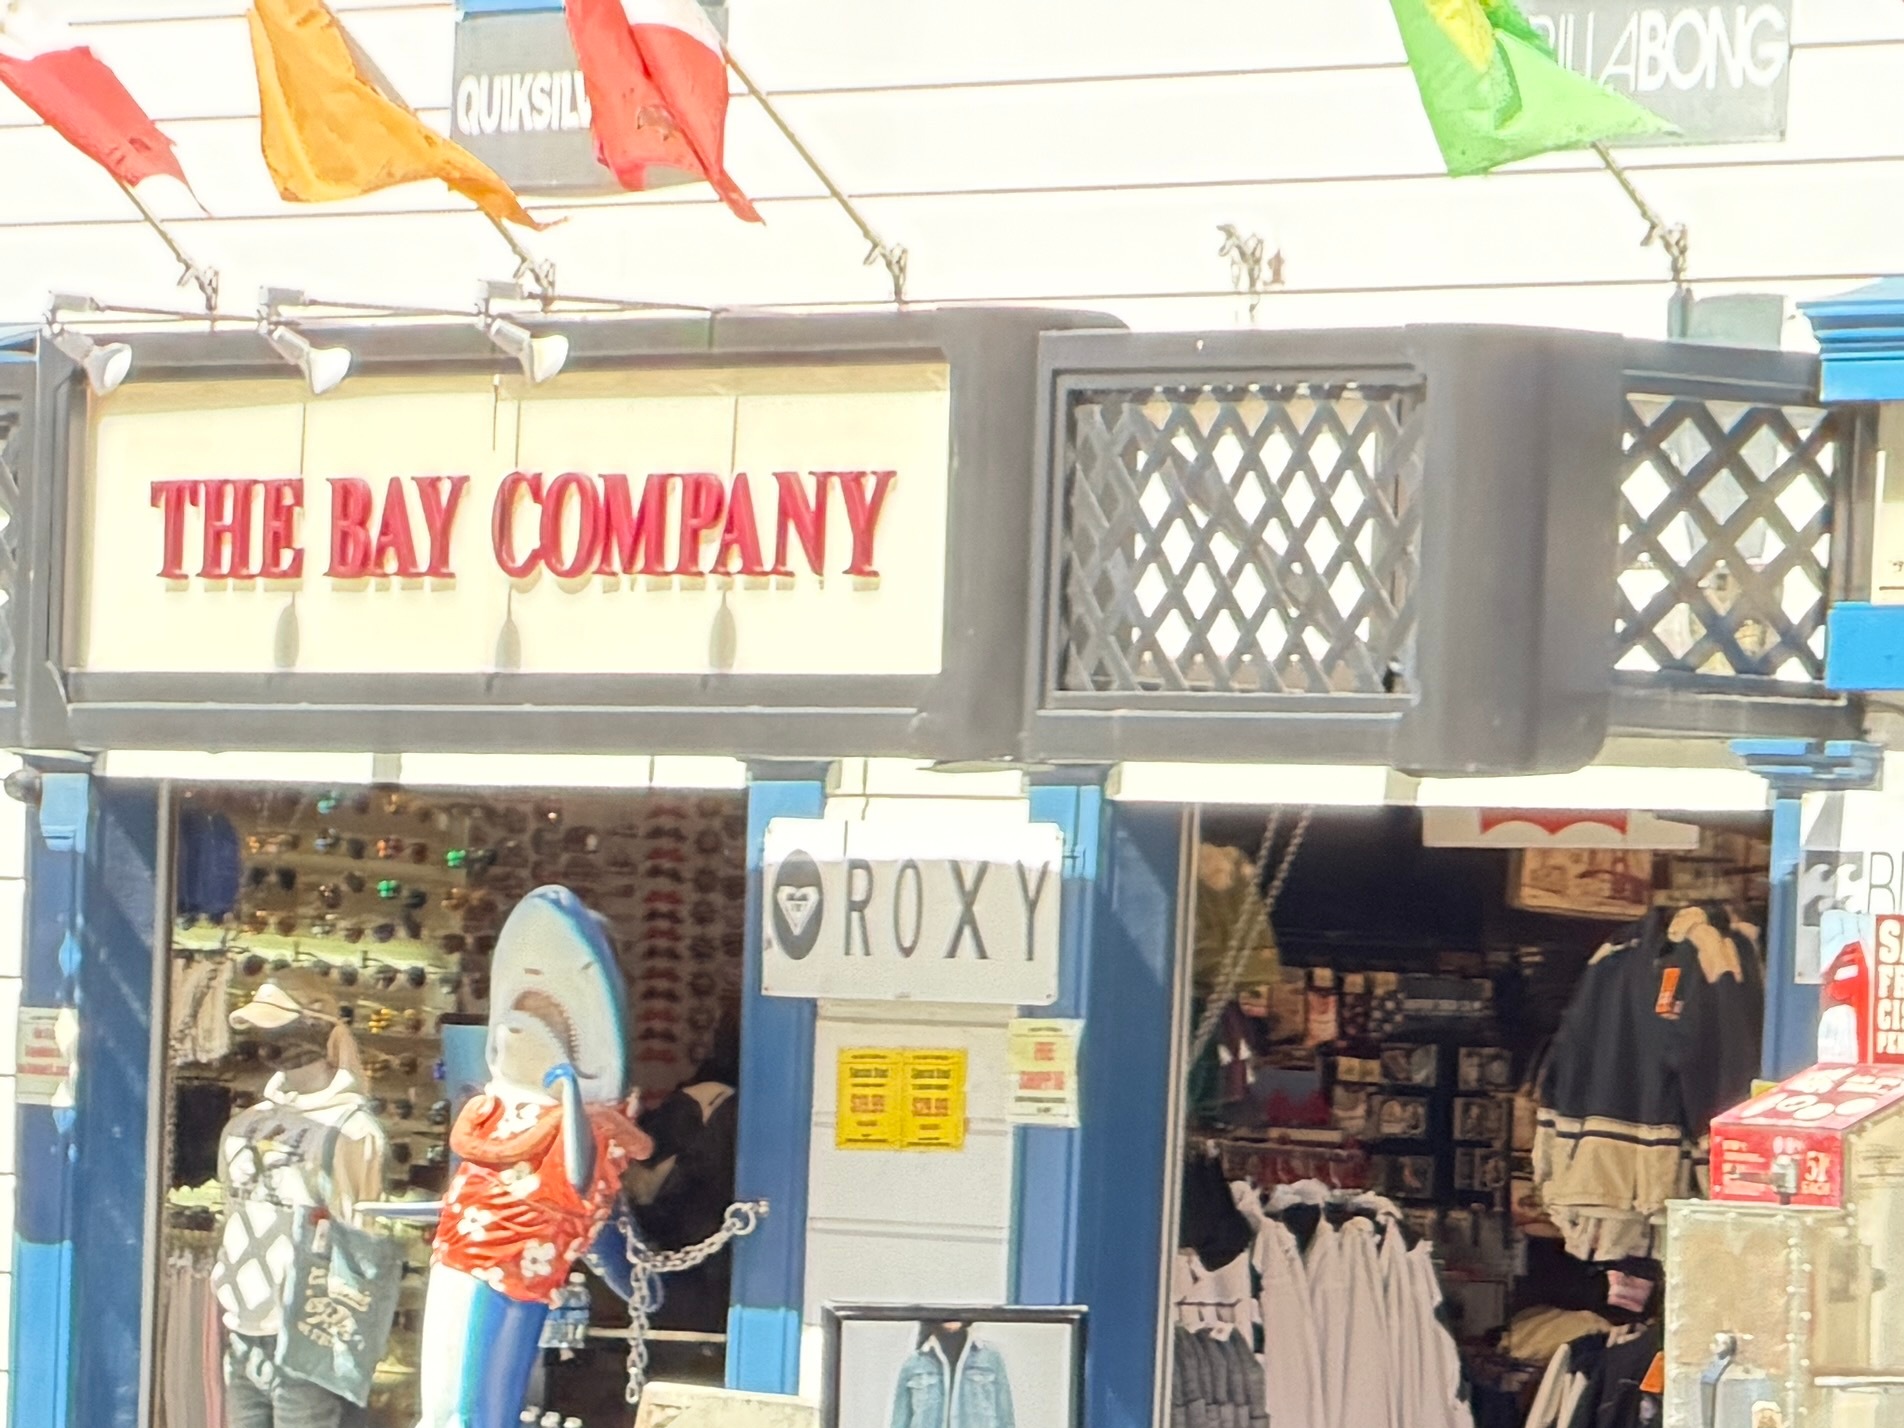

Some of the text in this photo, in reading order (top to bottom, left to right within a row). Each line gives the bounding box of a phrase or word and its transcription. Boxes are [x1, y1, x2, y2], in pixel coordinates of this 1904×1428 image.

[150, 470, 898, 581] THE BAY COMPANY
[844, 858, 1051, 962] ROXY
